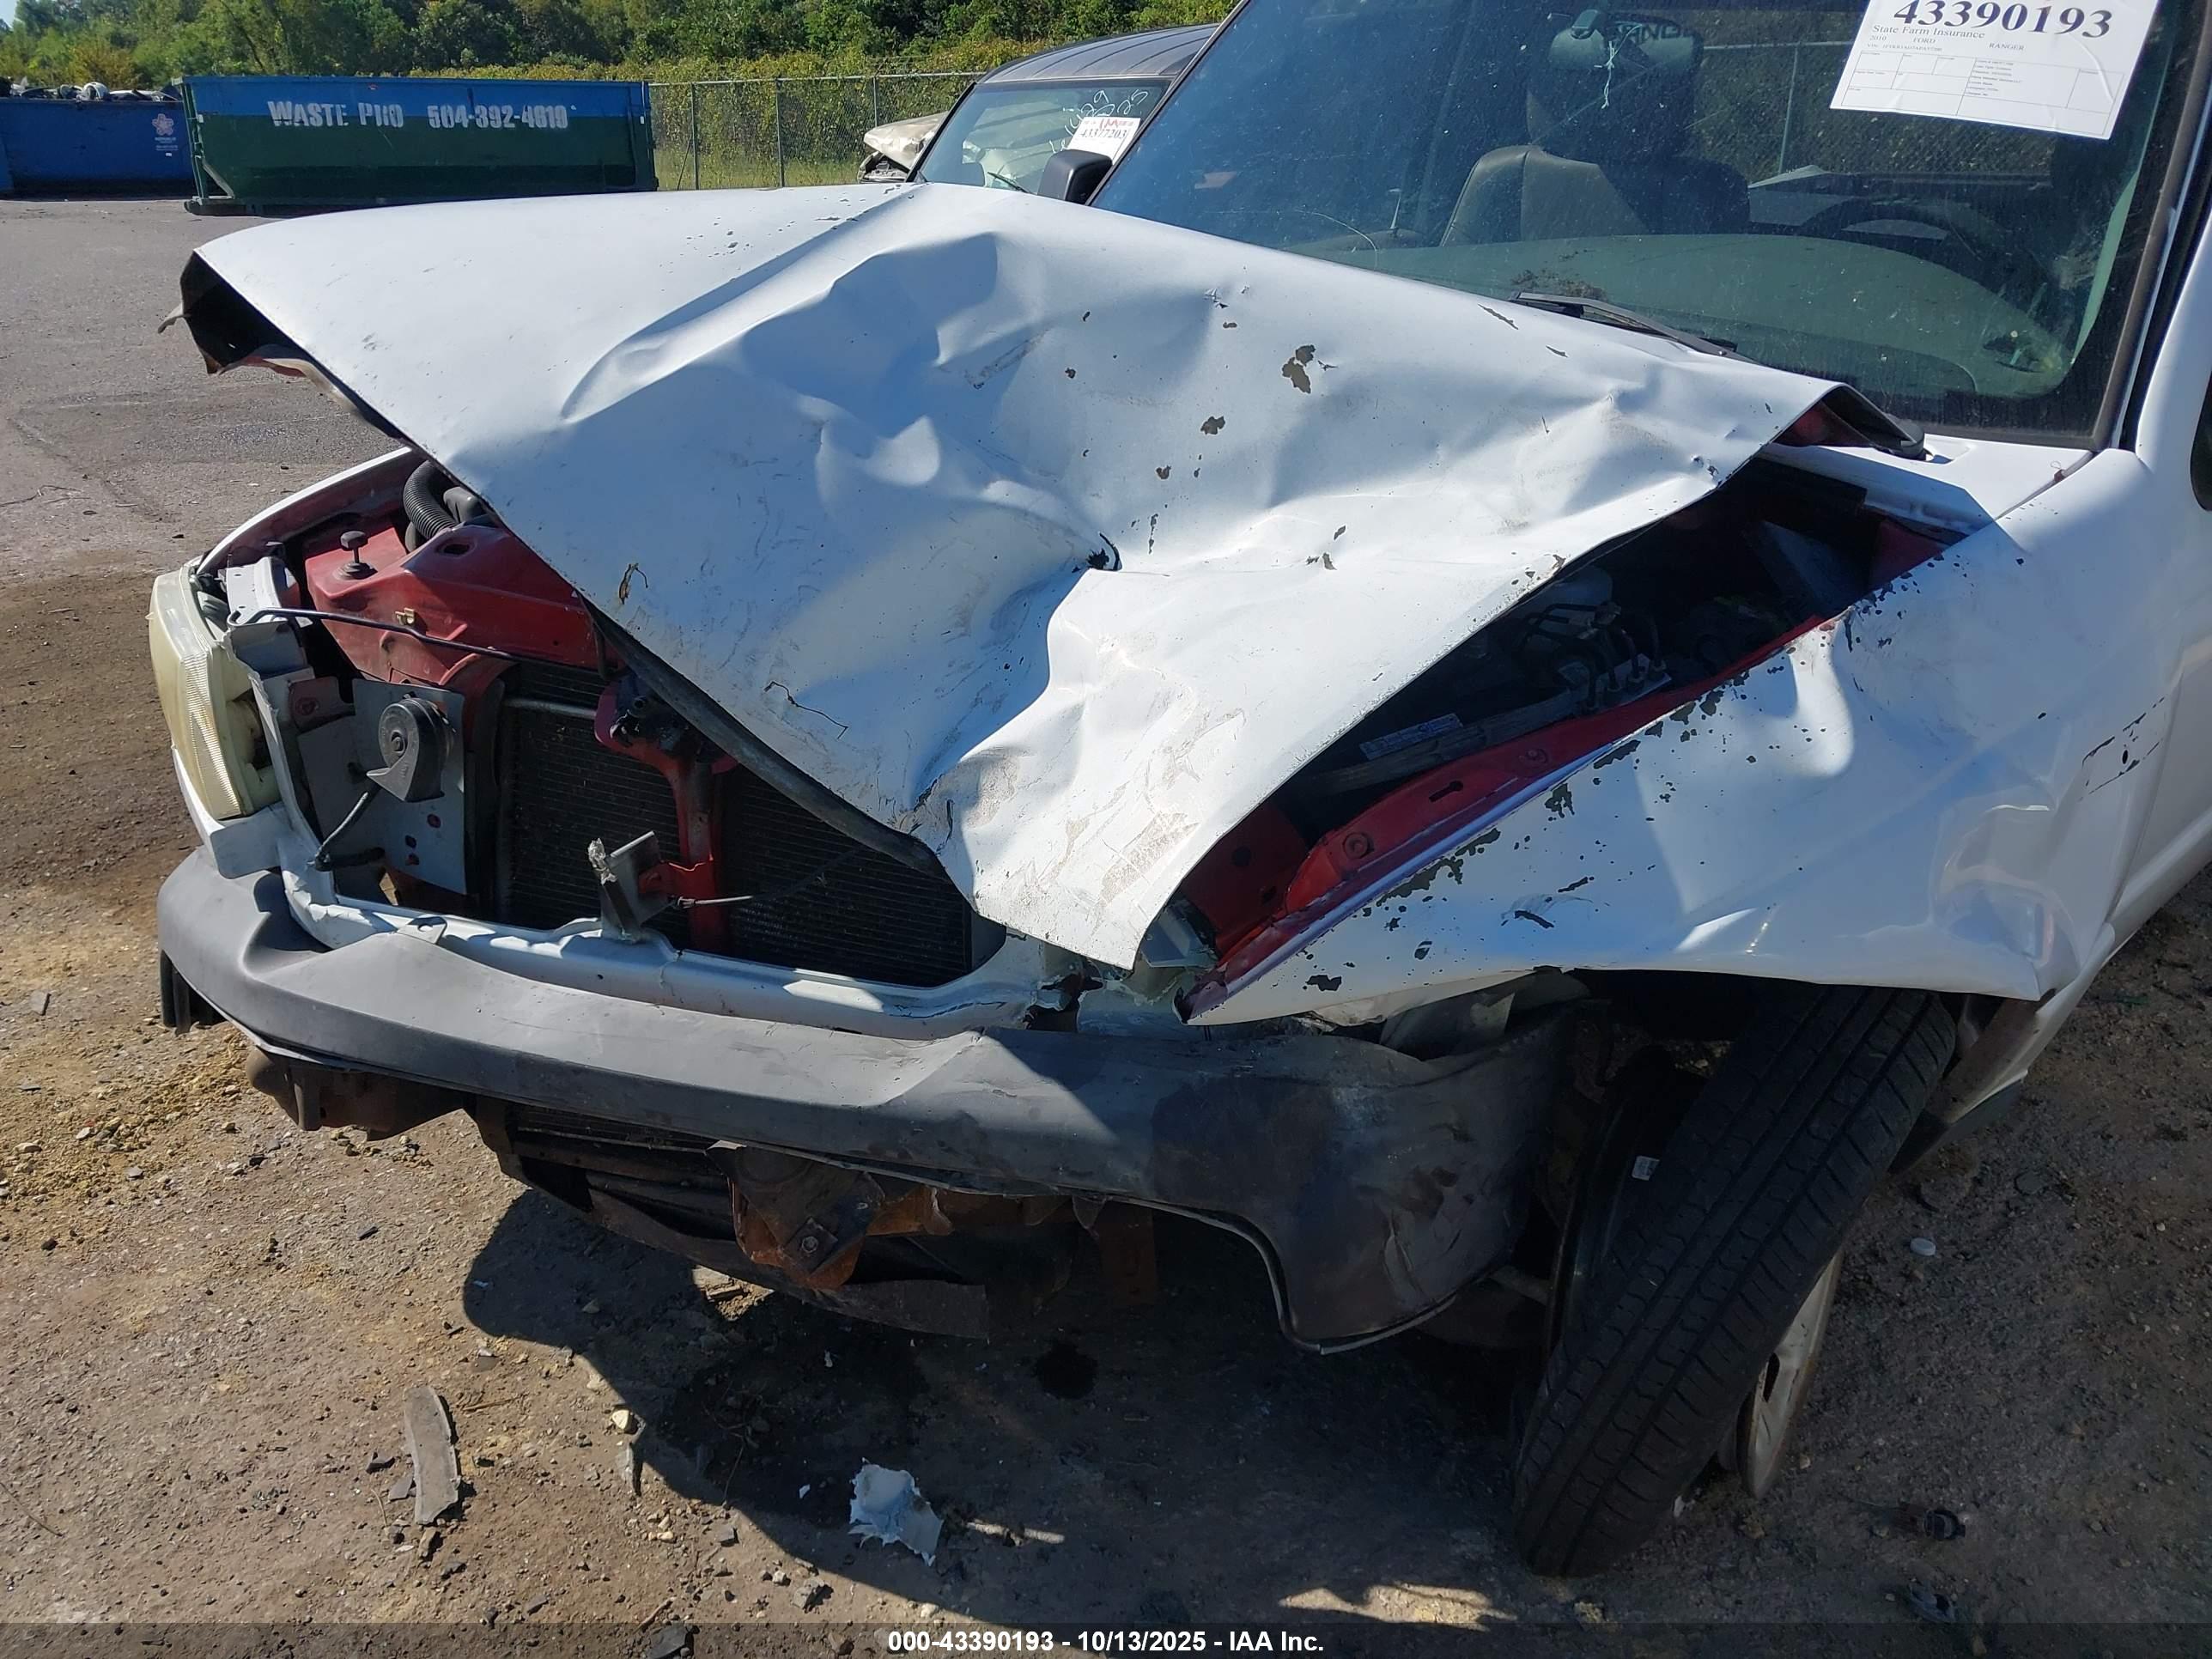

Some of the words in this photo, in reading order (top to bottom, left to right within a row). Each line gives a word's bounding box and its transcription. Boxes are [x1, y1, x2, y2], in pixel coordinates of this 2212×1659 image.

[1872, 24, 1899, 33] State
[1902, 26, 1930, 35] Farm
[1933, 28, 1985, 39] Insurance
[1893, 0, 2113, 39] 43390193
